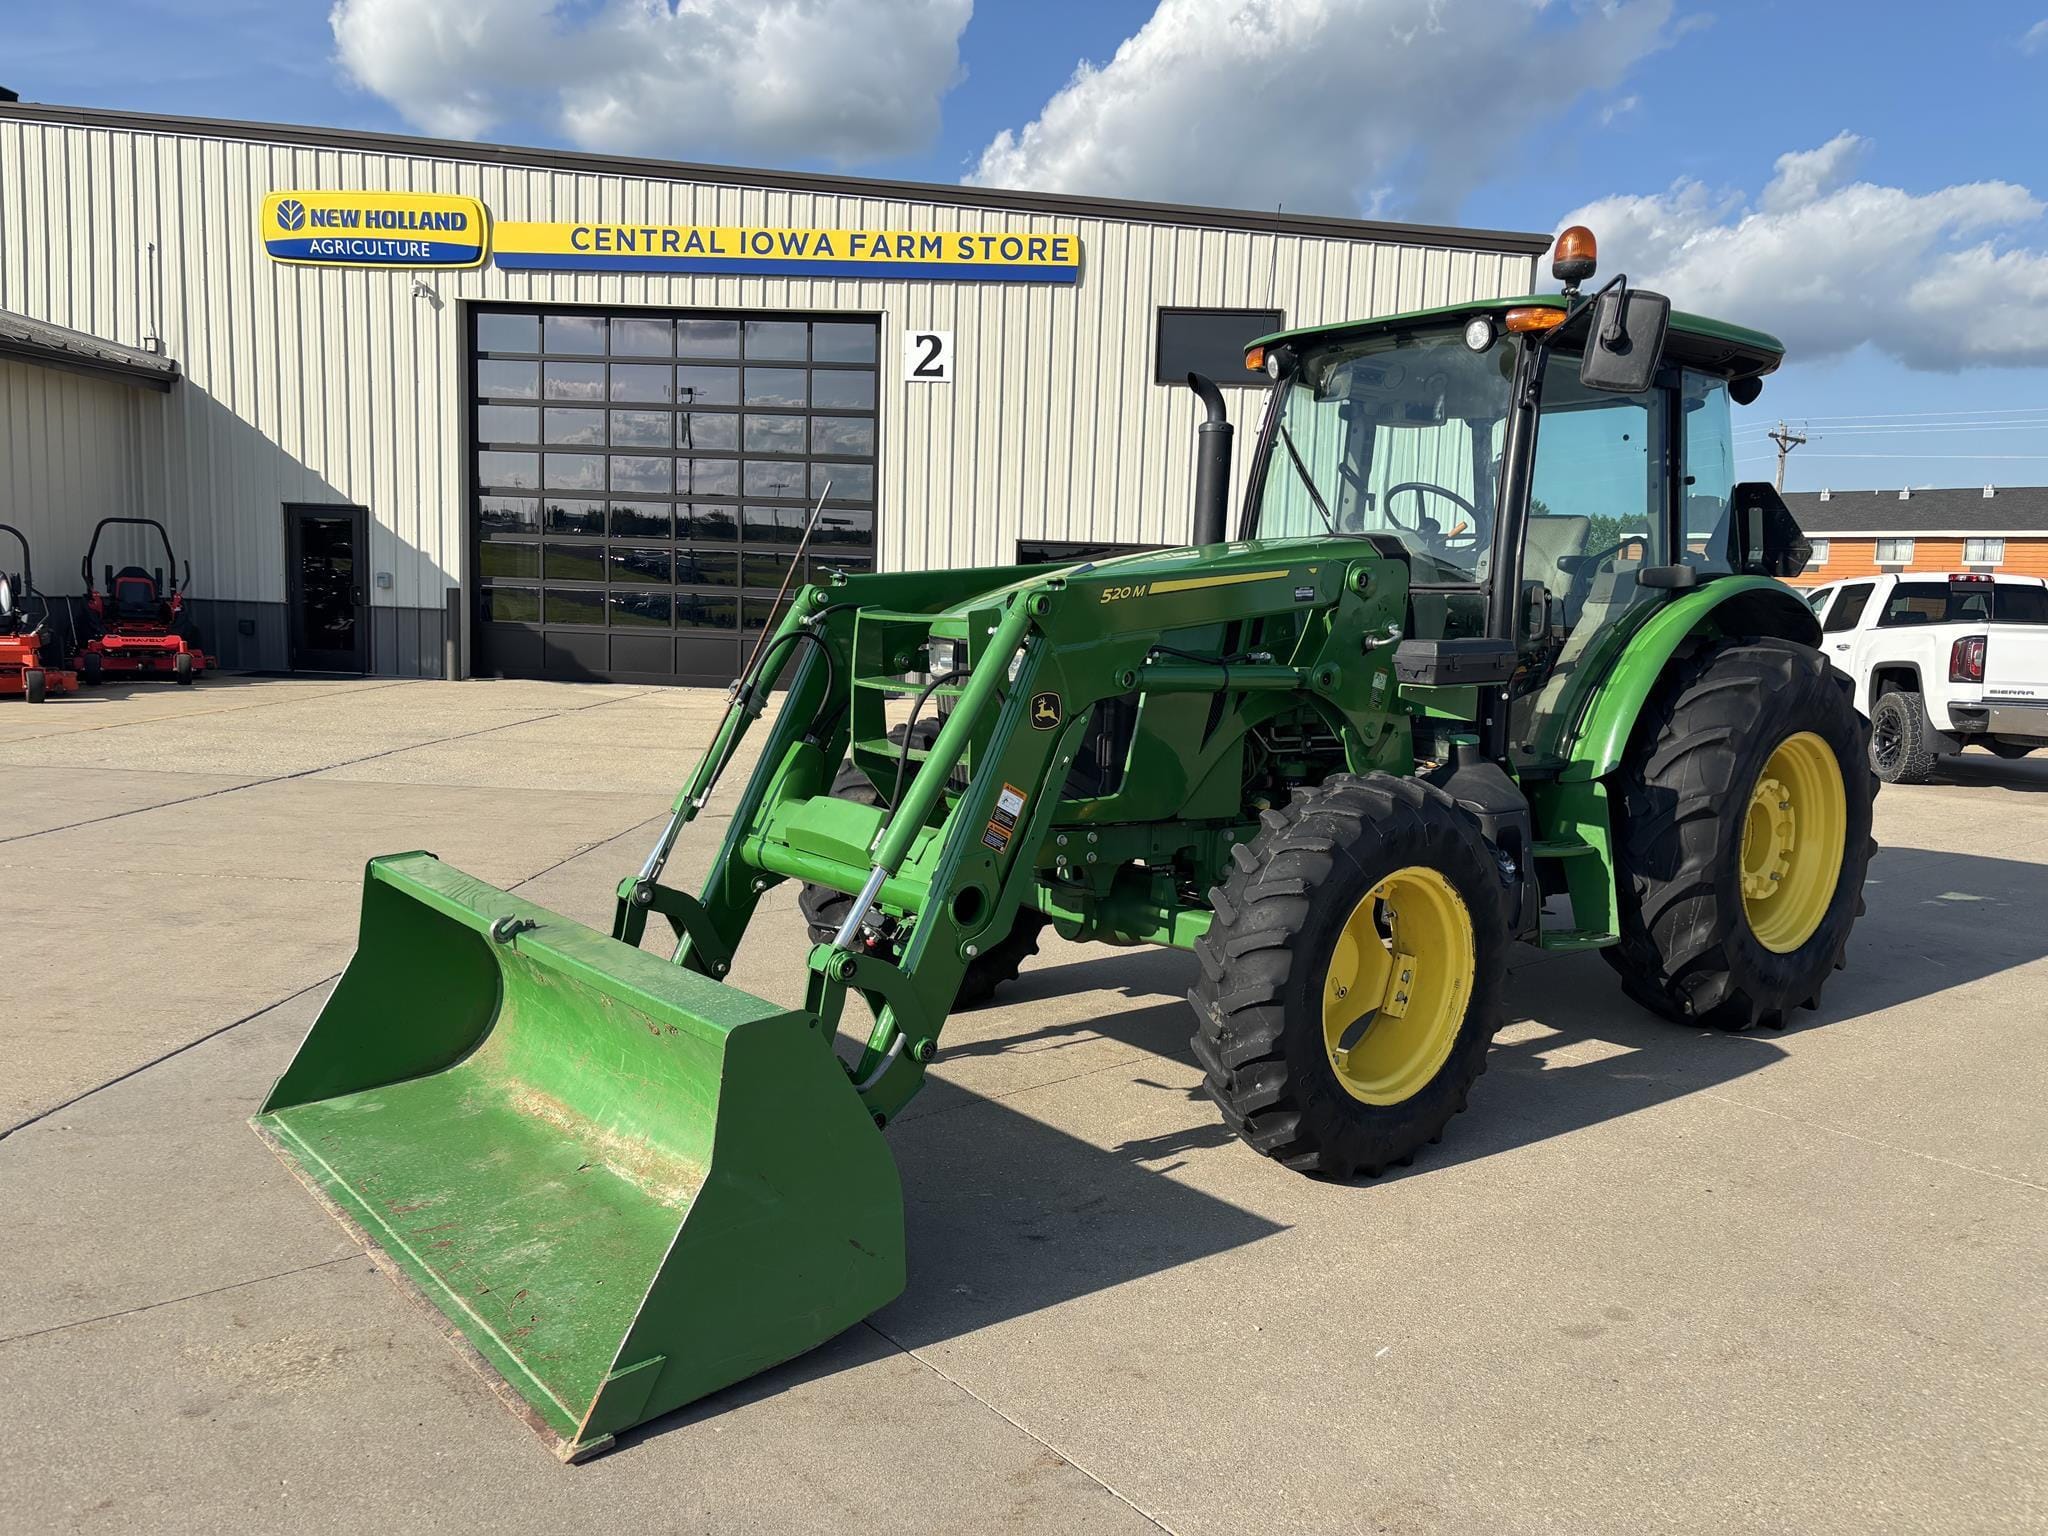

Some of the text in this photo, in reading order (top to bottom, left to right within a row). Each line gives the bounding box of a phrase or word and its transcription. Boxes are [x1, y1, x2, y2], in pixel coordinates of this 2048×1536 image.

[310, 208, 468, 231] NEW HOLLAND
[310, 239, 430, 257] AGRICULTURE
[571, 227, 1069, 261] CENTRAL IOWA FARM STORE
[913, 335, 944, 377] 2
